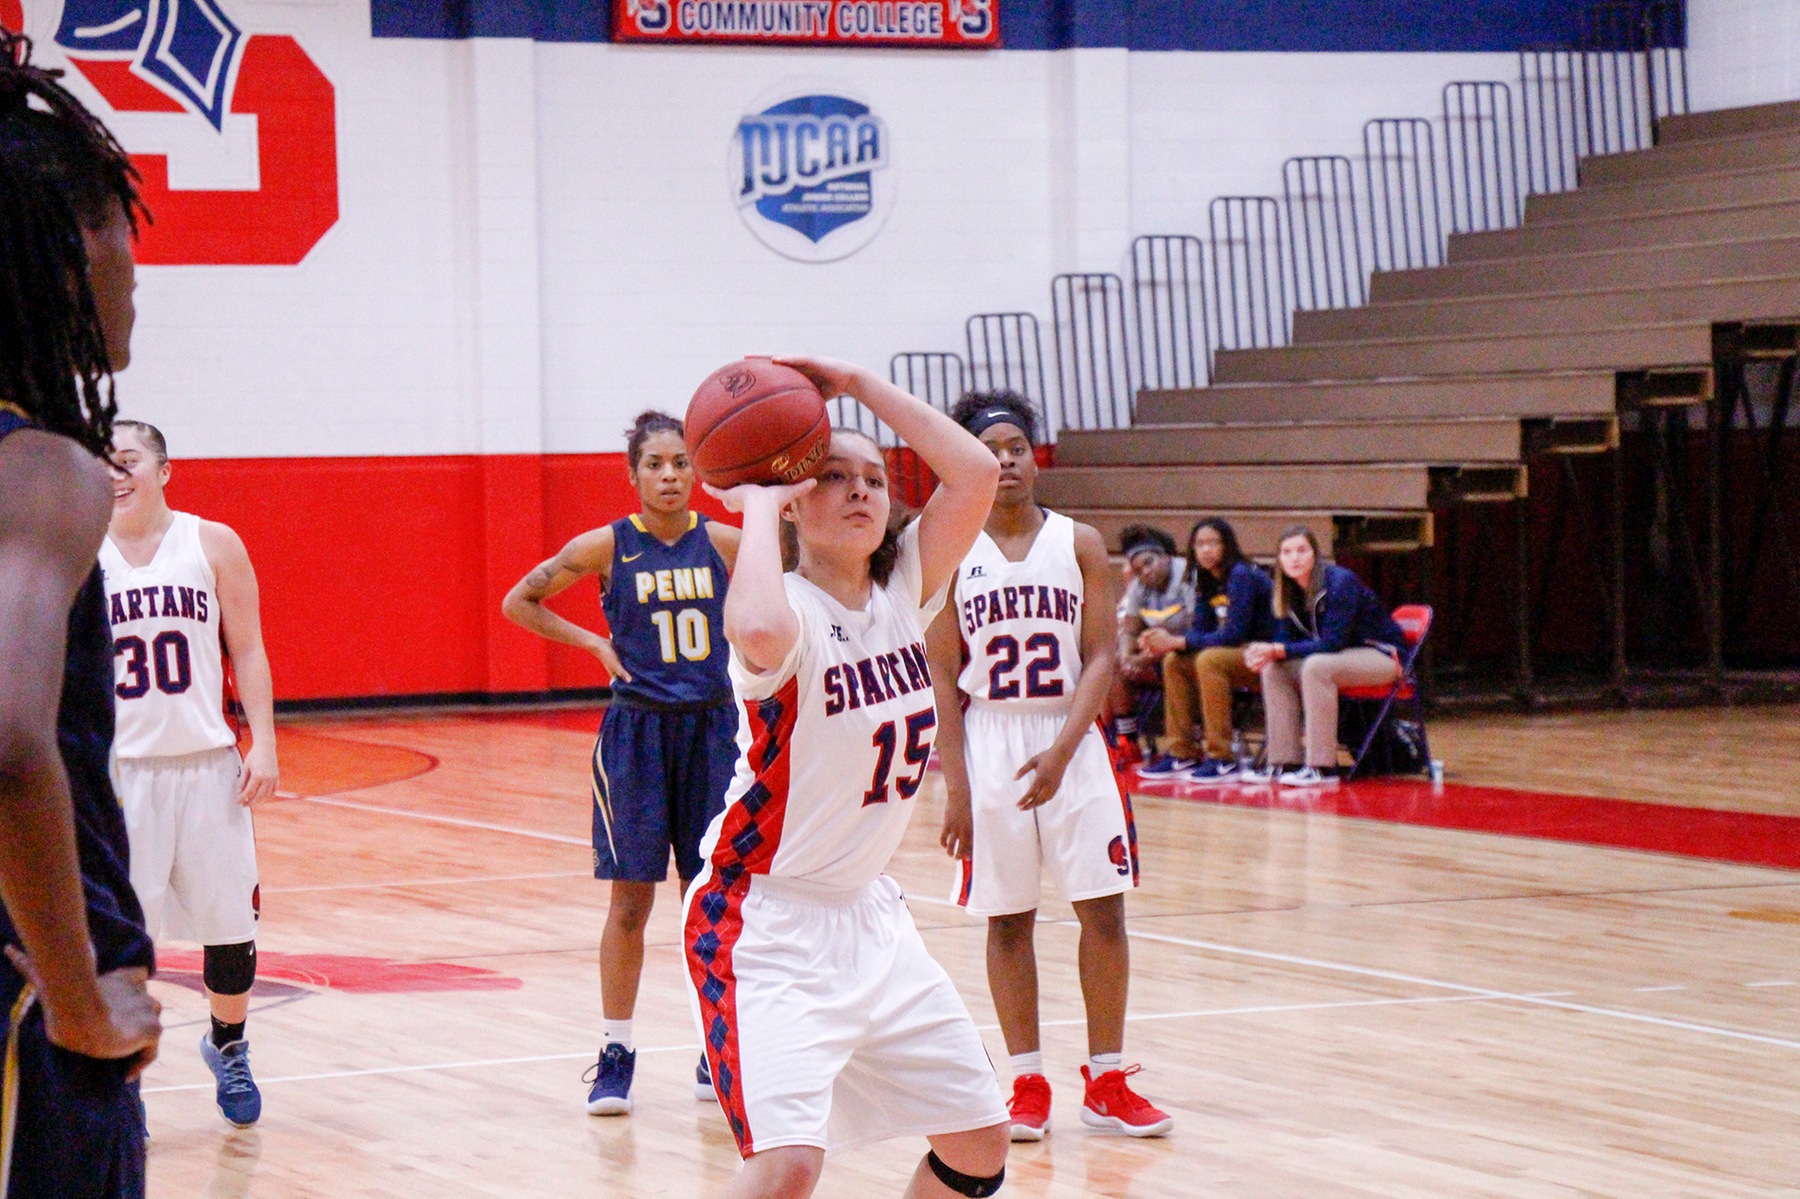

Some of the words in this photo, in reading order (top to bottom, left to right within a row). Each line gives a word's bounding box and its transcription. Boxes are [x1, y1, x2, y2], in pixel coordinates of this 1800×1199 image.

[677, 1, 830, 33] COMMUNITY
[838, 4, 942, 35] COLLEGE
[739, 122, 880, 195] NJCAA
[110, 586, 208, 625] ARTANS
[635, 567, 714, 603] PENN
[964, 585, 1078, 636] SPARTANS
[113, 630, 192, 700] 30
[651, 608, 711, 663] 10
[986, 632, 1064, 700] 22
[824, 642, 932, 717] SPARTAN
[862, 706, 937, 808] 15
